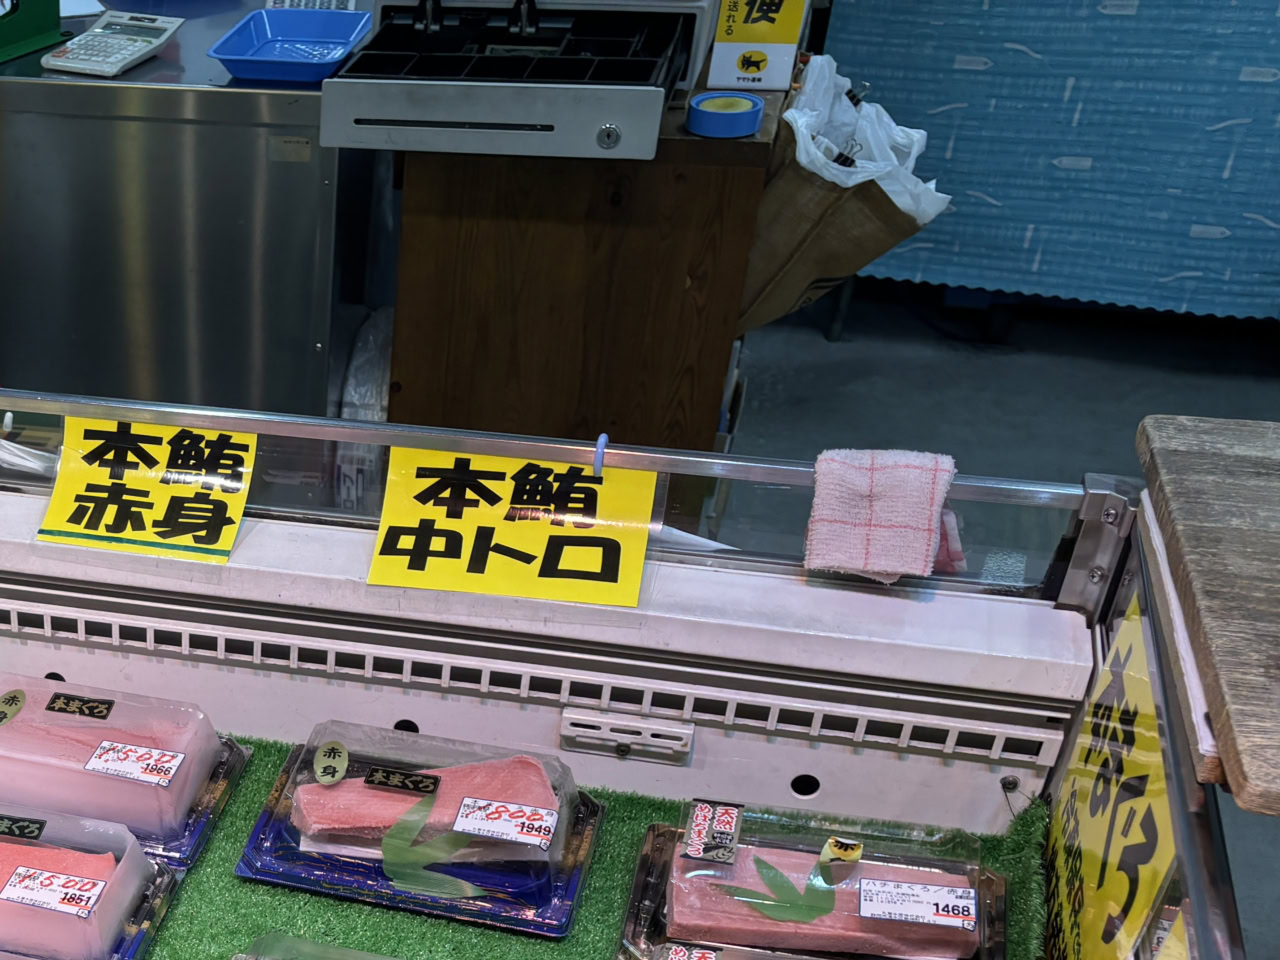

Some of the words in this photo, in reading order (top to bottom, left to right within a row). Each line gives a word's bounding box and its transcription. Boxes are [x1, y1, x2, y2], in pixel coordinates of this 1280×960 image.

[80, 421, 249, 494] 本鮪
[413, 457, 603, 530] 本鮪
[66, 482, 236, 546] 赤身
[378, 518, 621, 584] 中トロ
[50, 696, 109, 717] 本まぐろ
[143, 761, 173, 778] 1966
[319, 746, 342, 780] 赤身
[369, 768, 436, 792] 本まぐろ
[519, 821, 551, 836] 1949
[715, 807, 738, 832] 天然
[61, 891, 91, 906] 1851
[932, 902, 970, 917] 1468
